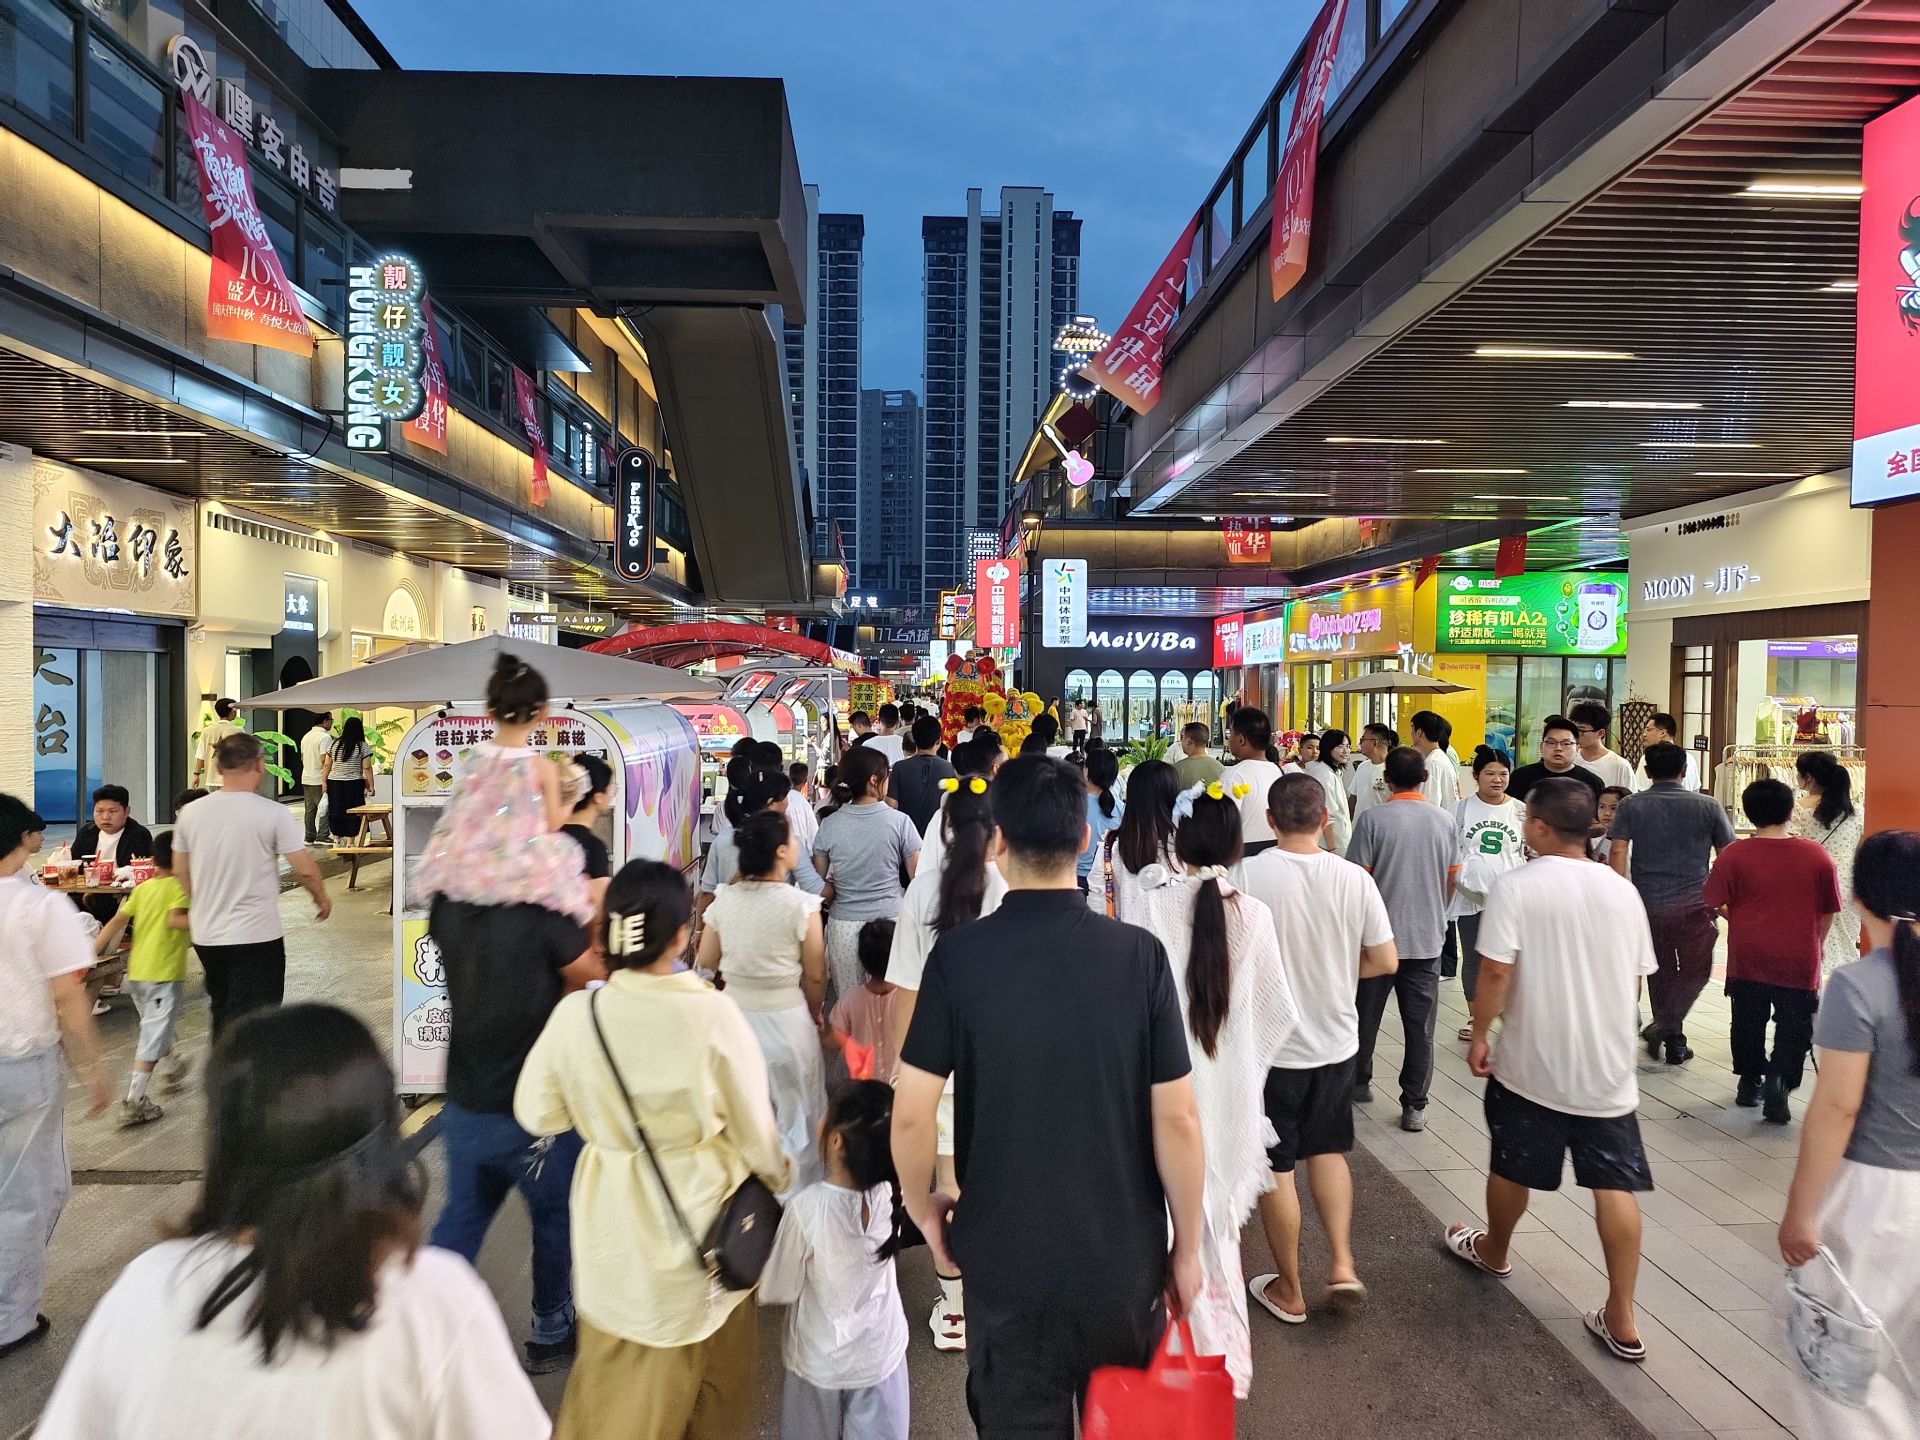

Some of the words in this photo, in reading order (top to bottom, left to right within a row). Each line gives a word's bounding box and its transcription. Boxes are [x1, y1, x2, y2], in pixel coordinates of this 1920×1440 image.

[227, 280, 294, 316] 盛大开街
[381, 264, 408, 406] 靓仔靓女
[346, 266, 382, 449] HUNGKUNG
[1643, 574, 1695, 601] MOON
[1059, 586, 1072, 645] 中国体育彩票
[1448, 610, 1543, 627] 珍稀有机A2
[1448, 627, 1496, 639] 舒适鼎配
[1501, 627, 1548, 639] 一喝就是
[854, 692, 874, 702] 凉面
[1479, 830, 1504, 855] S
